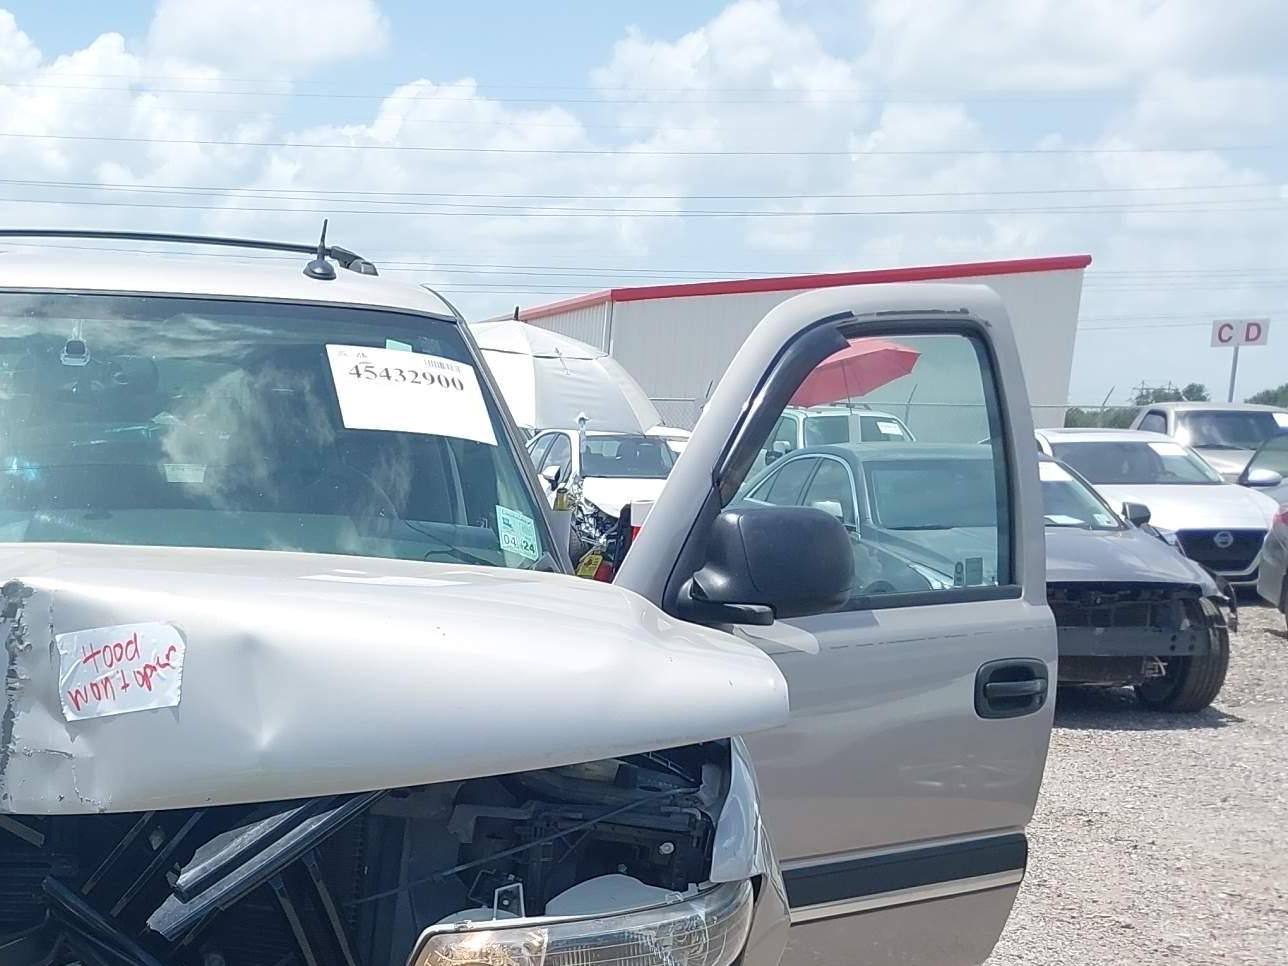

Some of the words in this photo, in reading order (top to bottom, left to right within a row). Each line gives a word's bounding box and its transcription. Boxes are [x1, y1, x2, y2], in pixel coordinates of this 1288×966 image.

[1218, 323, 1233, 343] C
[1245, 322, 1261, 342] D
[348, 363, 464, 391] 45432900
[522, 540, 535, 554] 24
